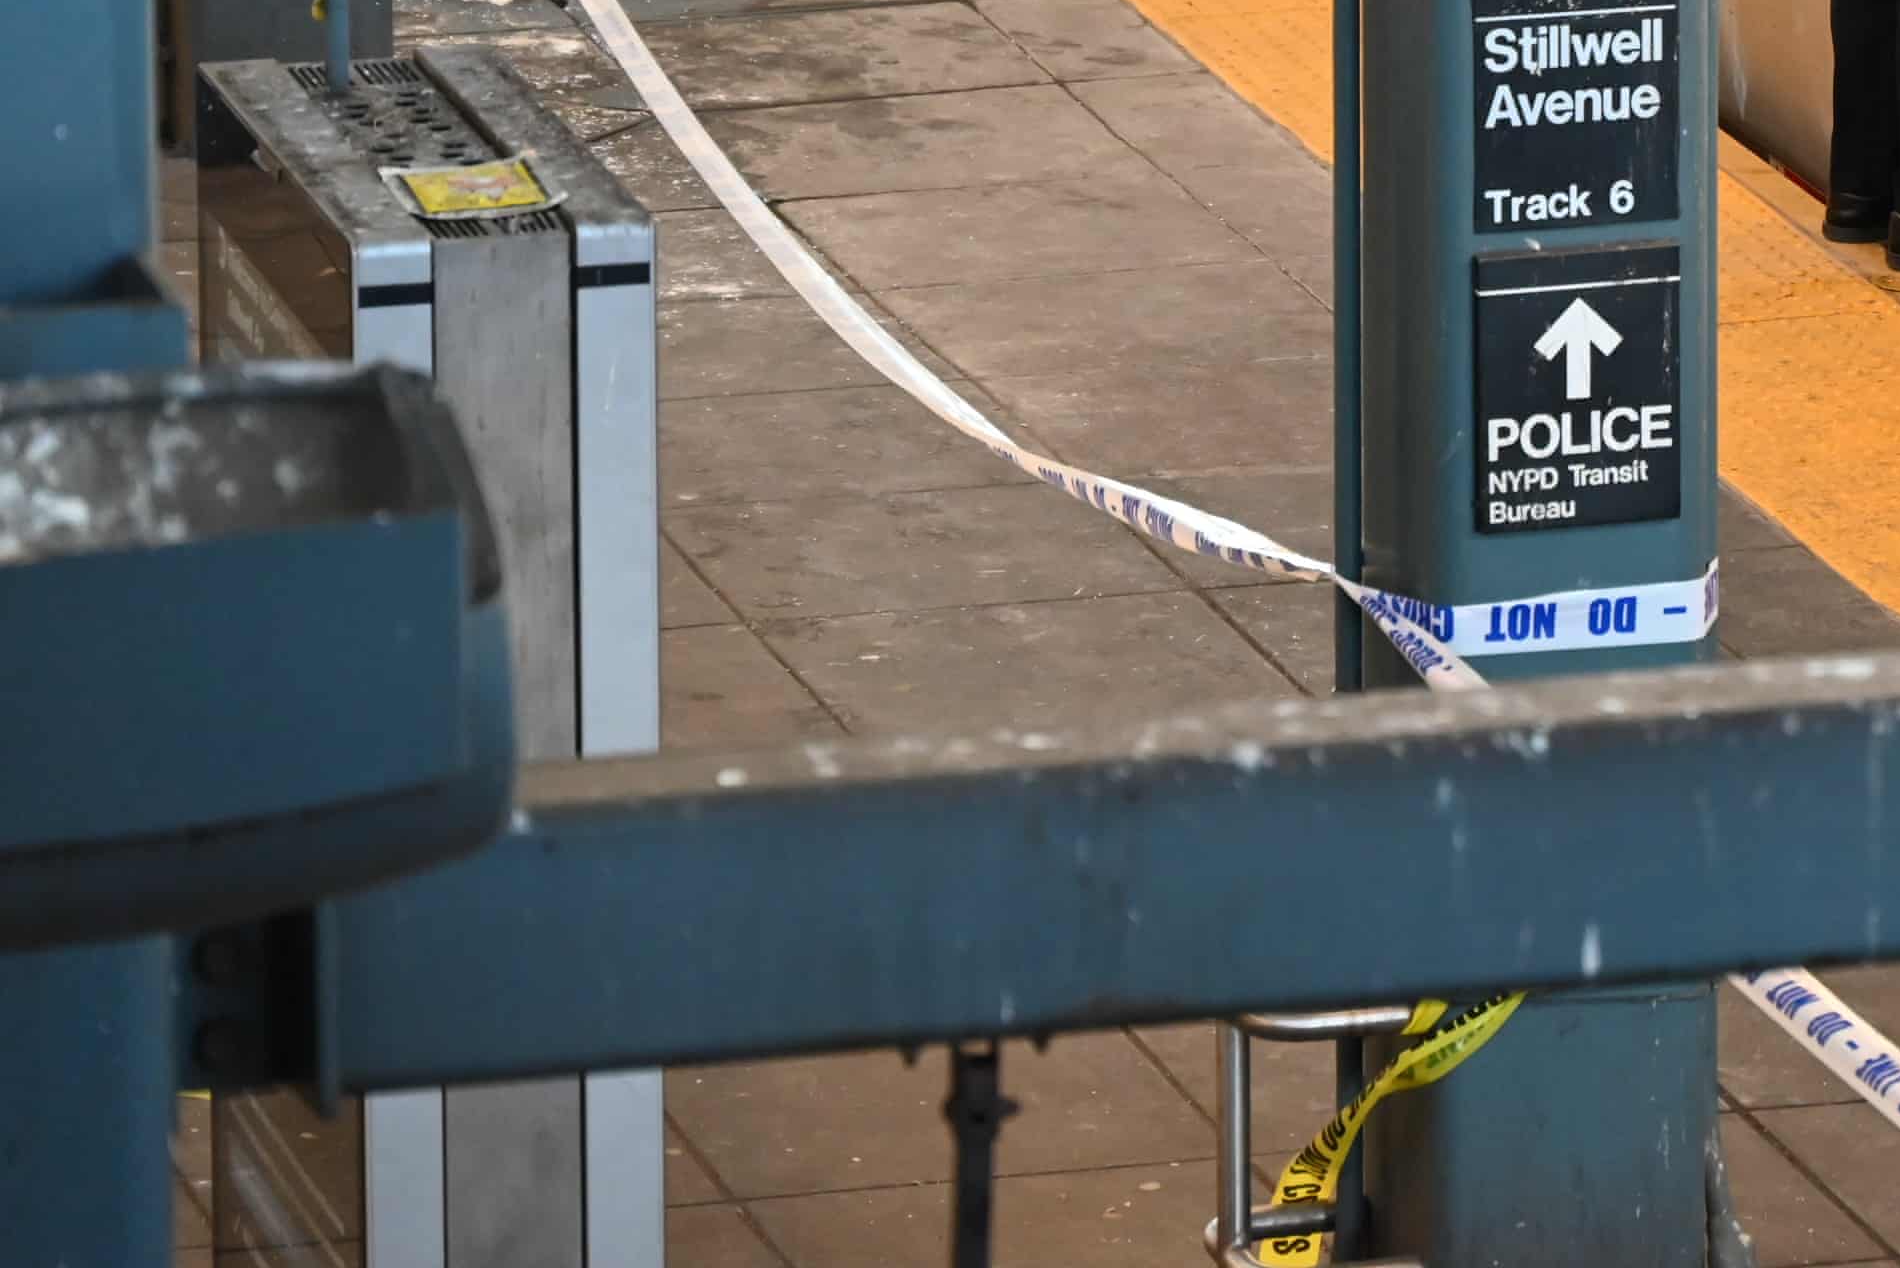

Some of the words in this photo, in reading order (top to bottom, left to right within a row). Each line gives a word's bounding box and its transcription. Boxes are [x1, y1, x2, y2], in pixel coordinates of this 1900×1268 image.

[1483, 18, 1663, 73] Stillwell
[1484, 83, 1662, 129] Avenue
[1483, 183, 1593, 224] Track
[1609, 179, 1635, 215] 6
[1488, 404, 1673, 462] POLICE
[1488, 466, 1560, 495] NYPD
[1567, 459, 1649, 487] Transit
[1488, 499, 1577, 525] Bureau
[1484, 601, 1558, 643] NOT
[1587, 595, 1638, 636] DO
[1765, 979, 1821, 1021] NOT
[1807, 1011, 1854, 1047] DO
